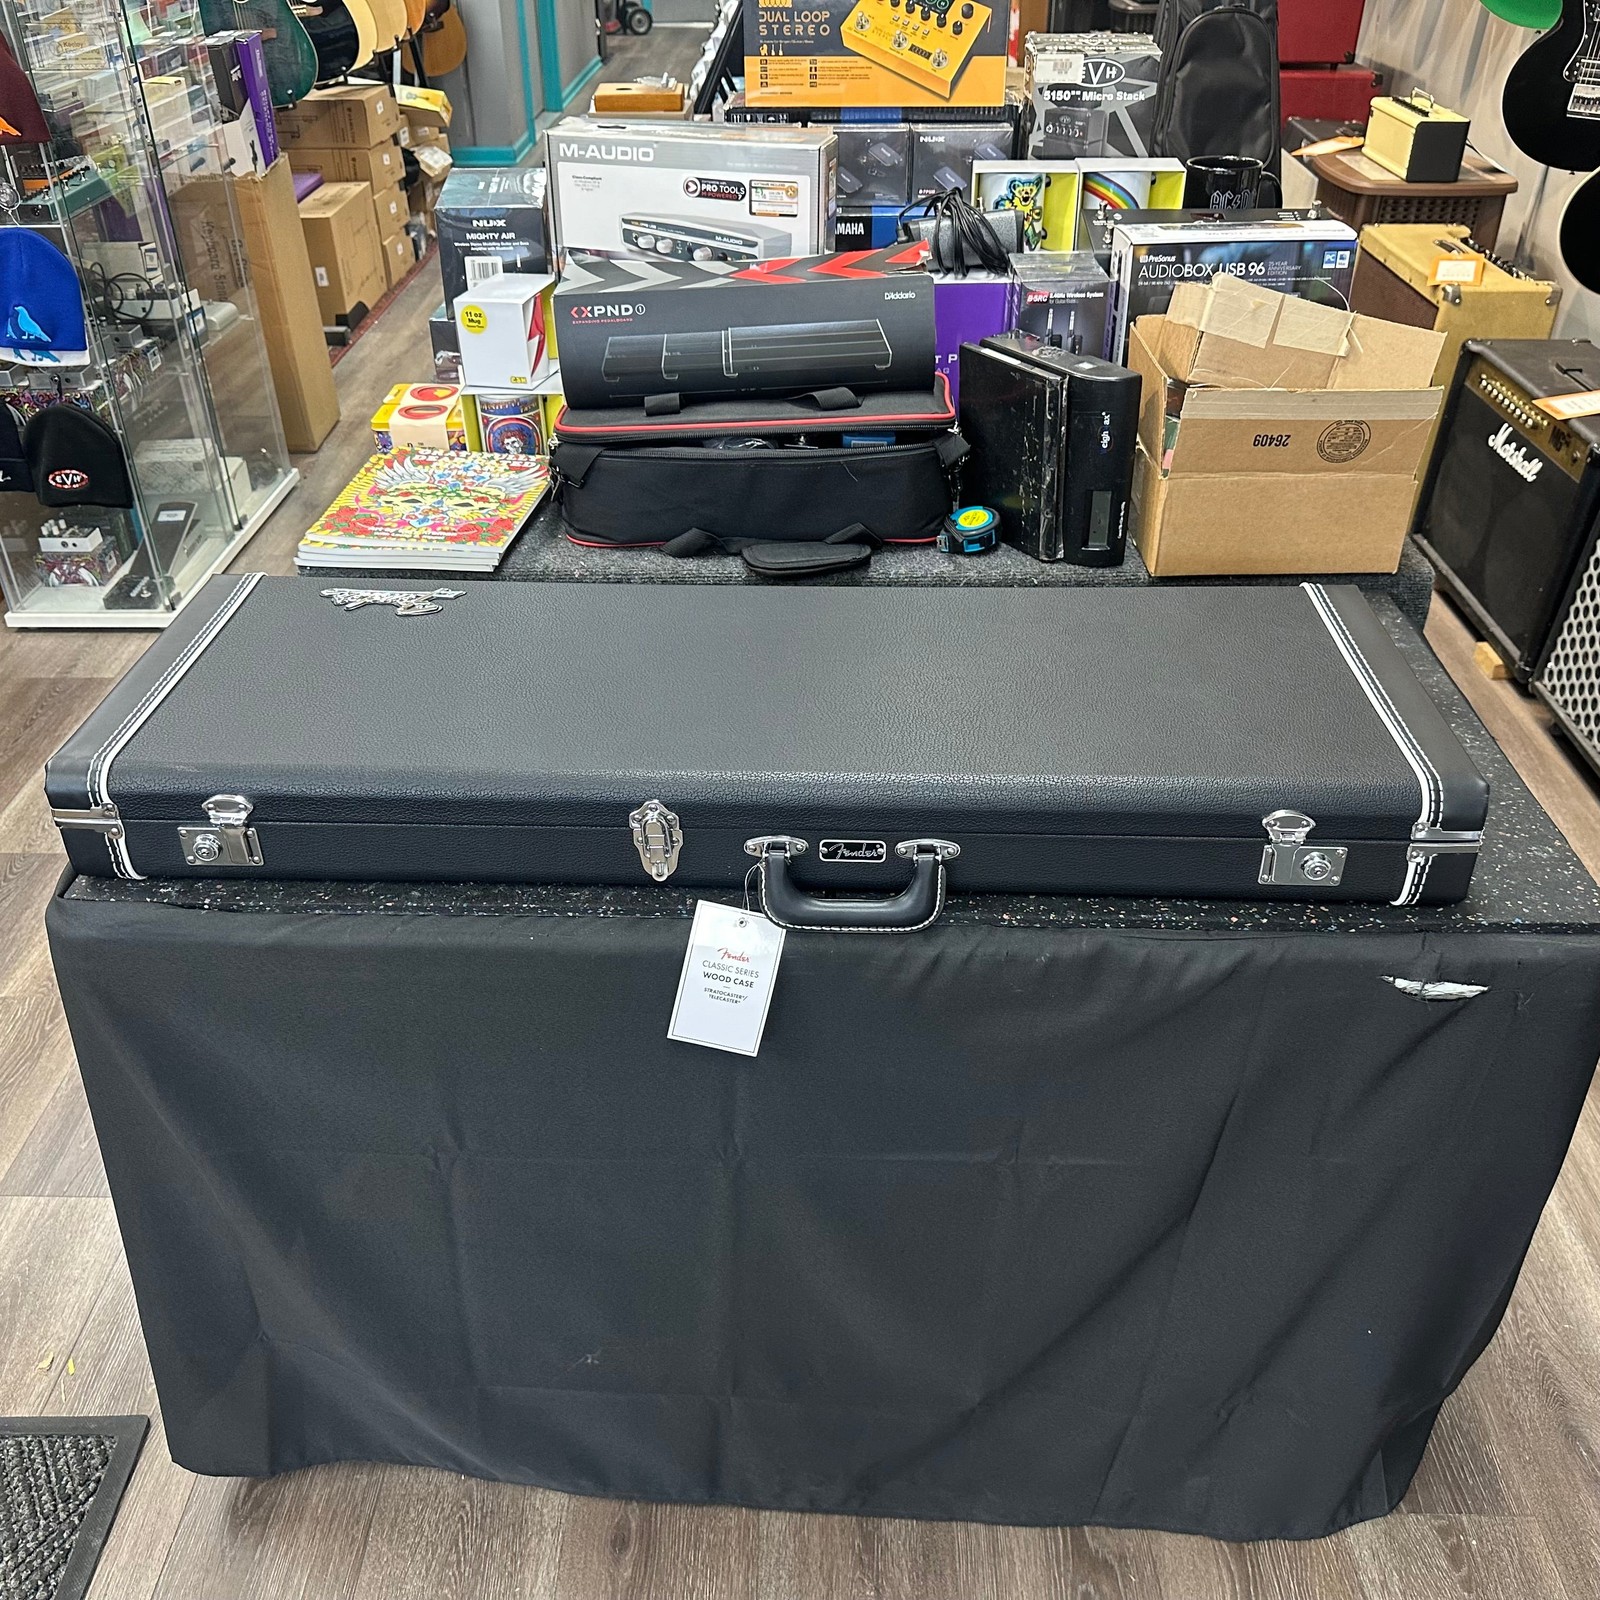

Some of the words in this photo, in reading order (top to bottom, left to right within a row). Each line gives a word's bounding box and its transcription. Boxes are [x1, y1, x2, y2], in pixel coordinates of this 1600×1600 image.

[759, 11, 790, 22] DUAL
[794, 10, 830, 22] LOOP
[759, 24, 831, 36] STEREO
[1082, 91, 1113, 101] Micro
[1116, 91, 1145, 101] Stack
[559, 142, 655, 162] M-AUDIO
[701, 183, 718, 193] PRO
[720, 185, 745, 195] TOOLS
[472, 219, 507, 227] NUX
[835, 222, 865, 235] MAHA
[715, 235, 743, 245] M-AUDIO
[1148, 254, 1177, 263] PreSonus
[1138, 262, 1213, 279] AUDIOBOX
[1248, 261, 1266, 276] 96
[884, 291, 916, 300] D'Addario
[1086, 292, 1104, 300] System
[468, 317, 481, 325] Mug
[1252, 434, 1292, 448] 26409
[1488, 422, 1544, 482] Marshall
[55, 473, 82, 485] EVH
[829, 842, 880, 860] Fender
[717, 947, 751, 963] Fender
[702, 959, 734, 973] CLASSIC
[734, 966, 760, 979] SERIES
[703, 971, 732, 983] WOOD
[733, 977, 755, 989] CASE
